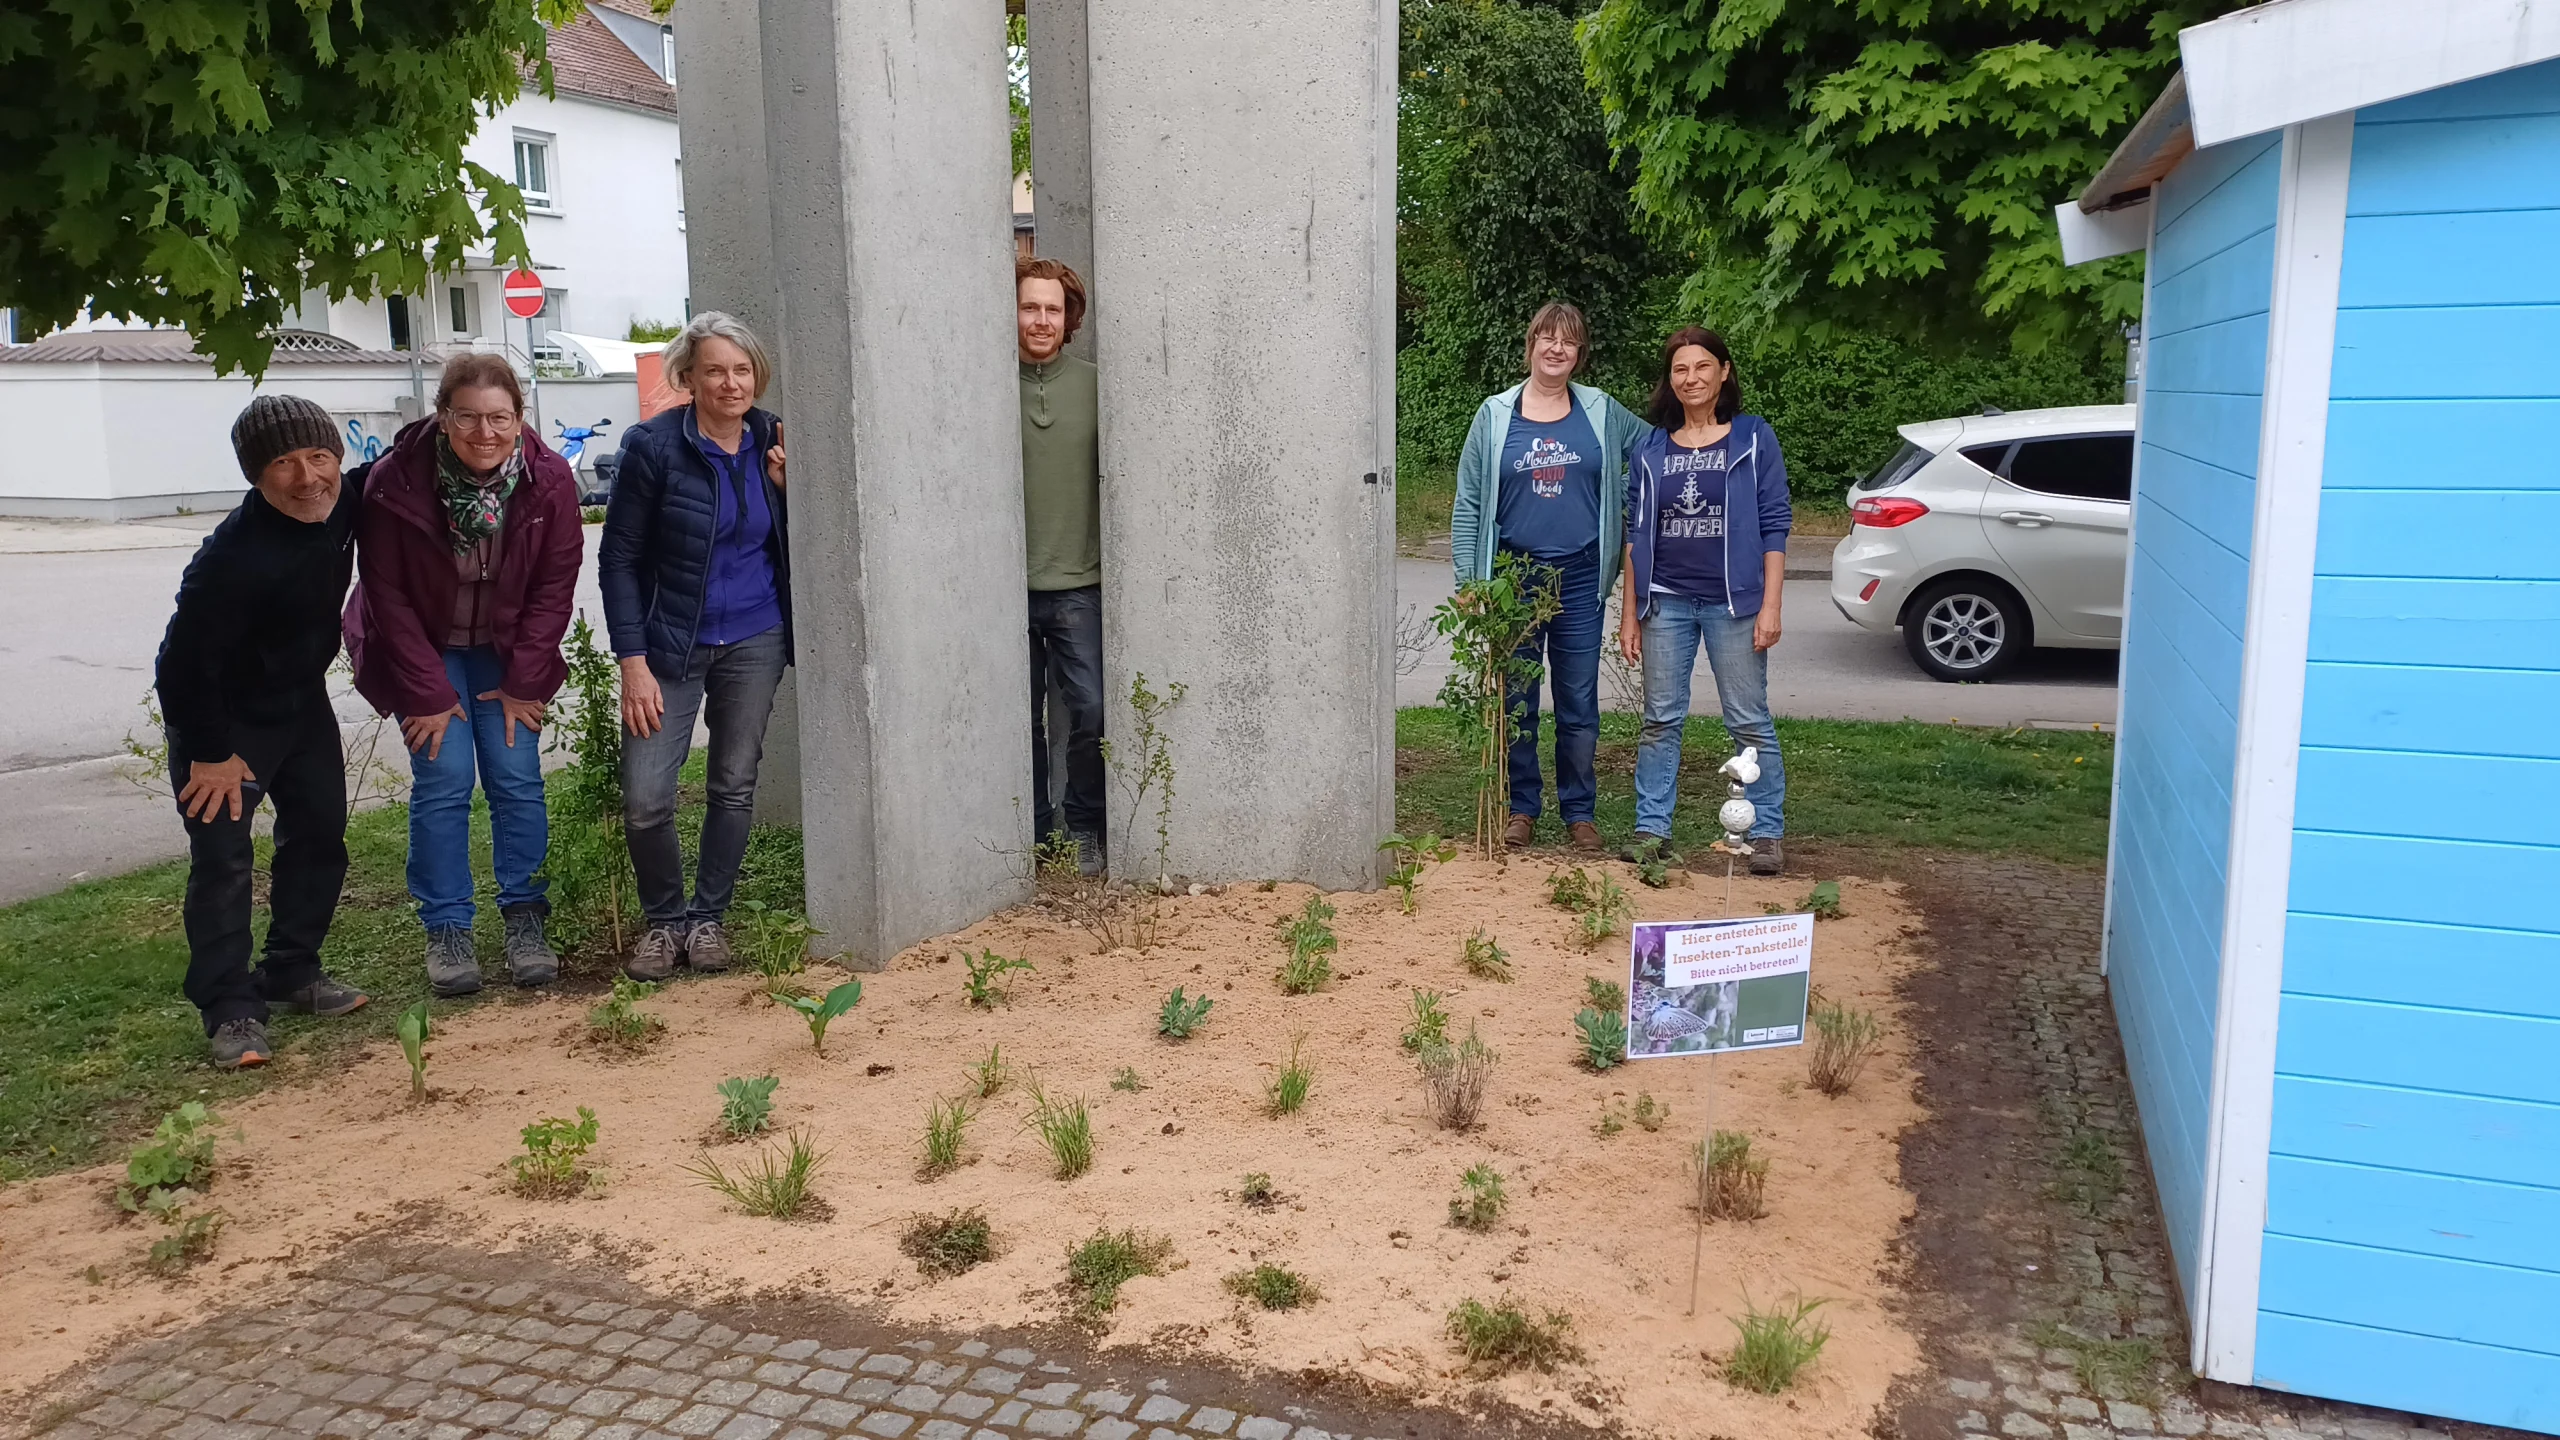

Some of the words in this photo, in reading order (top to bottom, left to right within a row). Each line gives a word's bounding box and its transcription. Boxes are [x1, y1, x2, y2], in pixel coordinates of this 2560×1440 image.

[1532, 437, 1567, 452] Over
[1513, 450, 1582, 470] Mountains
[1542, 466, 1565, 481] INTO
[1532, 479, 1564, 495] Woods
[1708, 505, 1722, 516] XO
[1661, 517, 1724, 538] LOVER
[1682, 933, 1712, 945] Hier
[1715, 924, 1767, 941] entsteht
[1770, 921, 1797, 933] eine
[1673, 935, 1808, 964] Insekten-Tankstelle!
[1690, 968, 1716, 979] Bitte
[1718, 963, 1747, 975] nicht
[1750, 954, 1799, 971] betreten!
